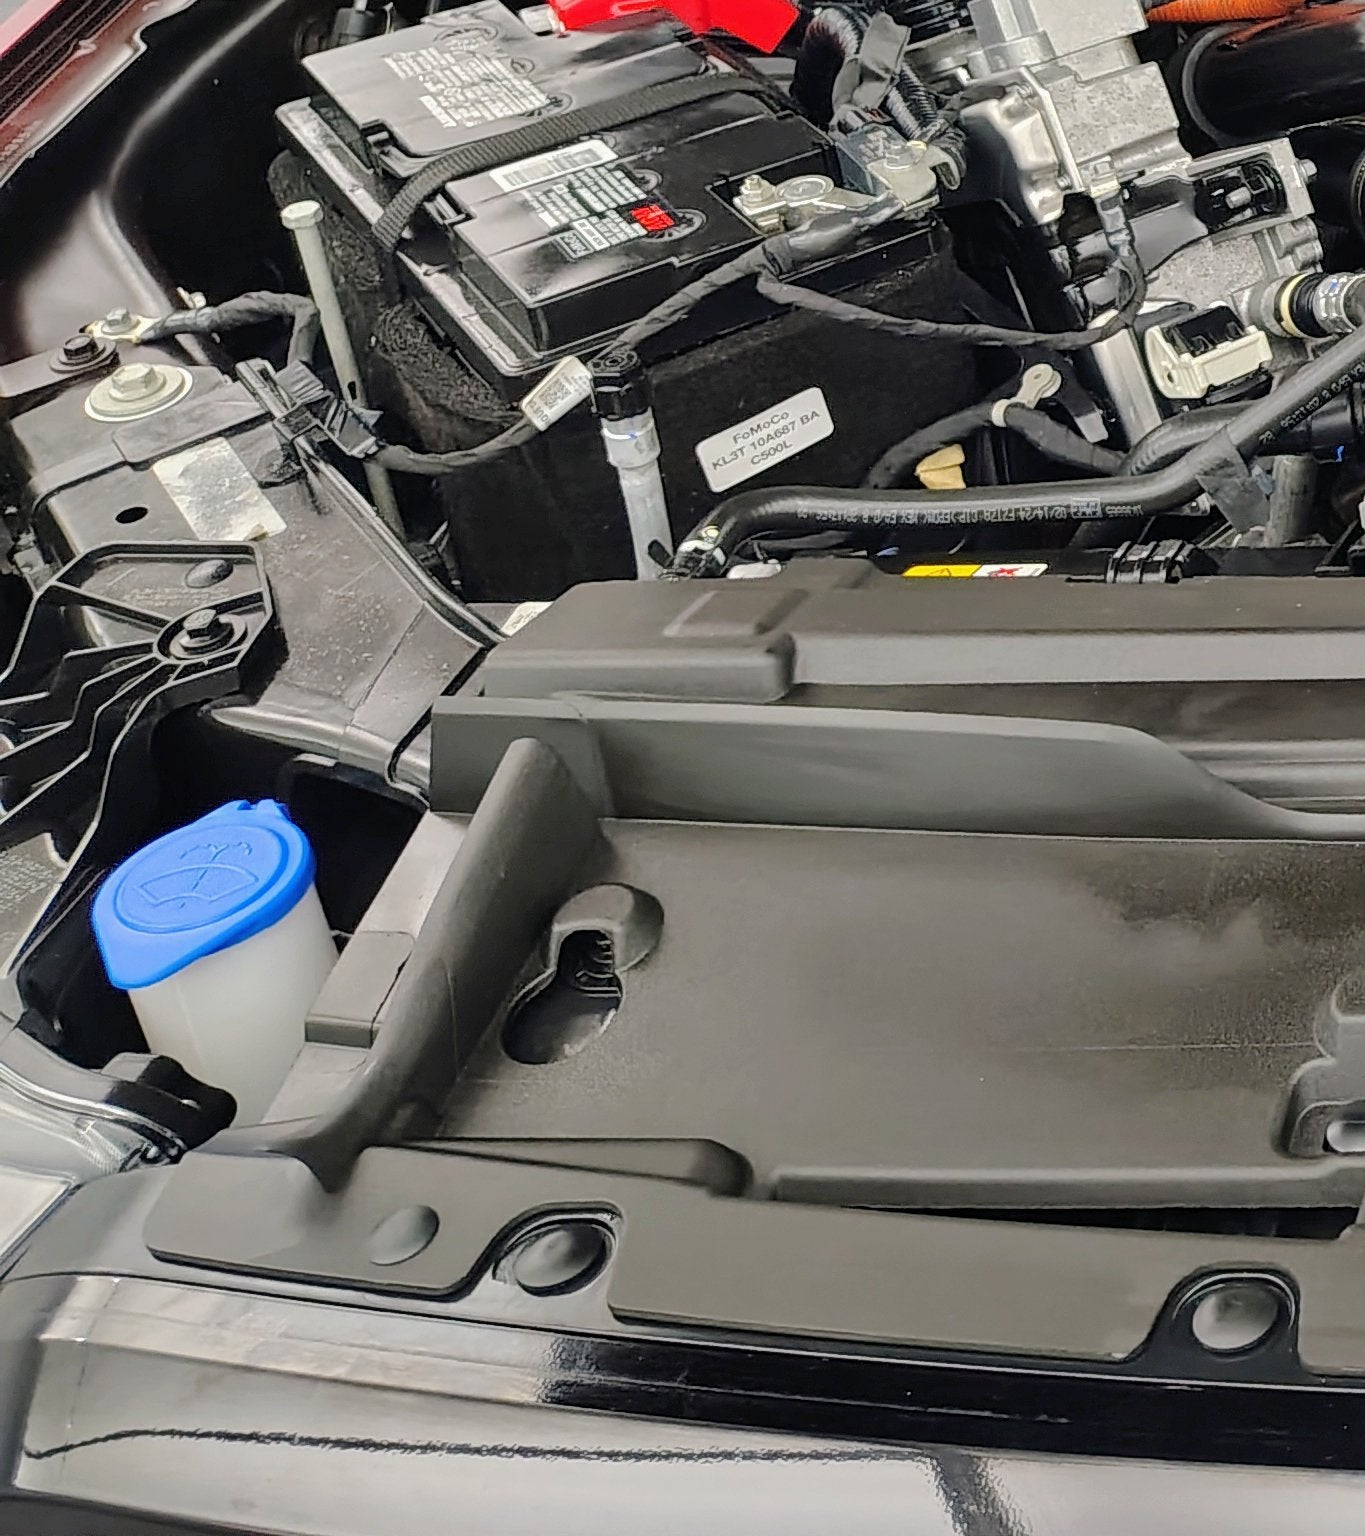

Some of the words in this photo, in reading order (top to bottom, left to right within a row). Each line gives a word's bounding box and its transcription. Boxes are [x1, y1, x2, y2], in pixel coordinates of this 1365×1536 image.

[712, 445, 747, 471] KL3T
[750, 420, 797, 451] 10A687
[800, 410, 821, 427] BA
[732, 411, 790, 445] FoMoCo
[750, 439, 793, 466] C500L
